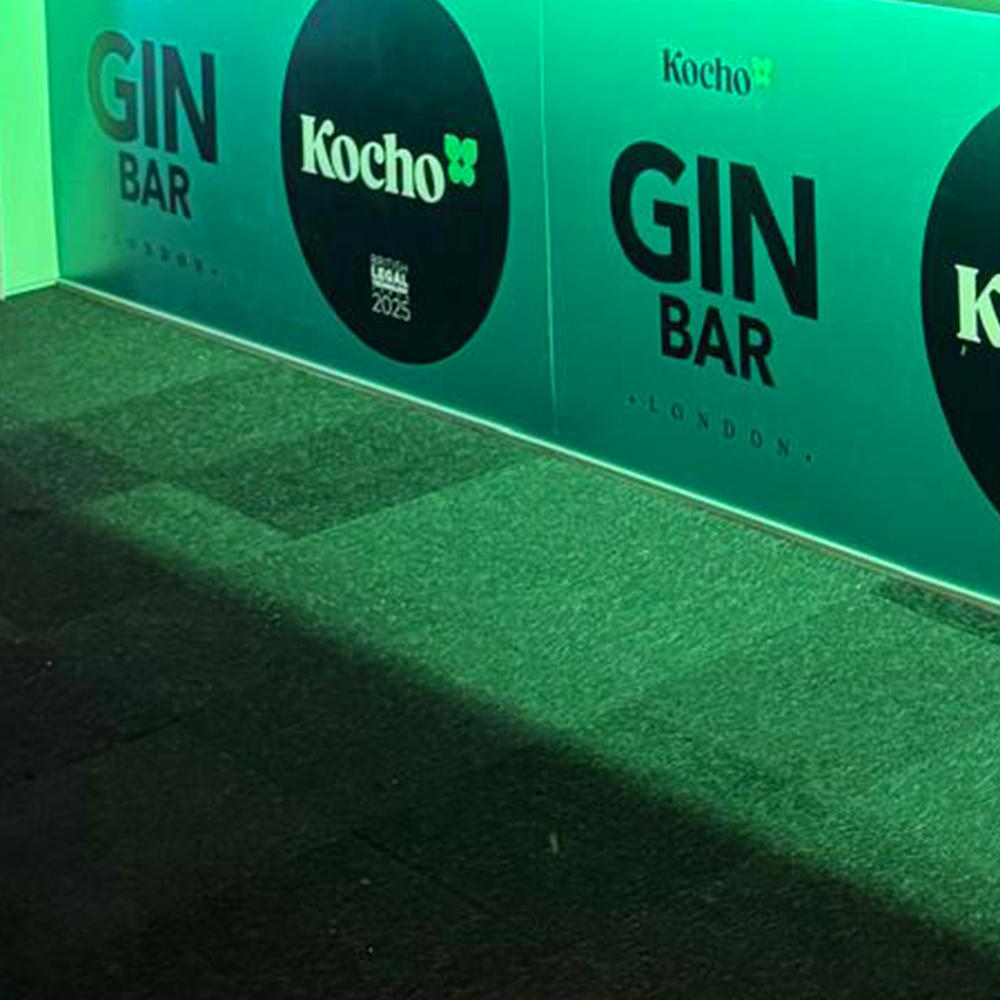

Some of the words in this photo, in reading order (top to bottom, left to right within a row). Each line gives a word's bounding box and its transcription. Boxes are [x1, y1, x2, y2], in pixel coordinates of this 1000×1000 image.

[88, 30, 218, 164] GIN
[662, 48, 751, 95] Kocho
[119, 150, 192, 220] BAR
[300, 113, 445, 203] Kocho
[610, 140, 818, 320] GIN
[371, 292, 411, 322] 2025
[659, 293, 775, 387] BAR
